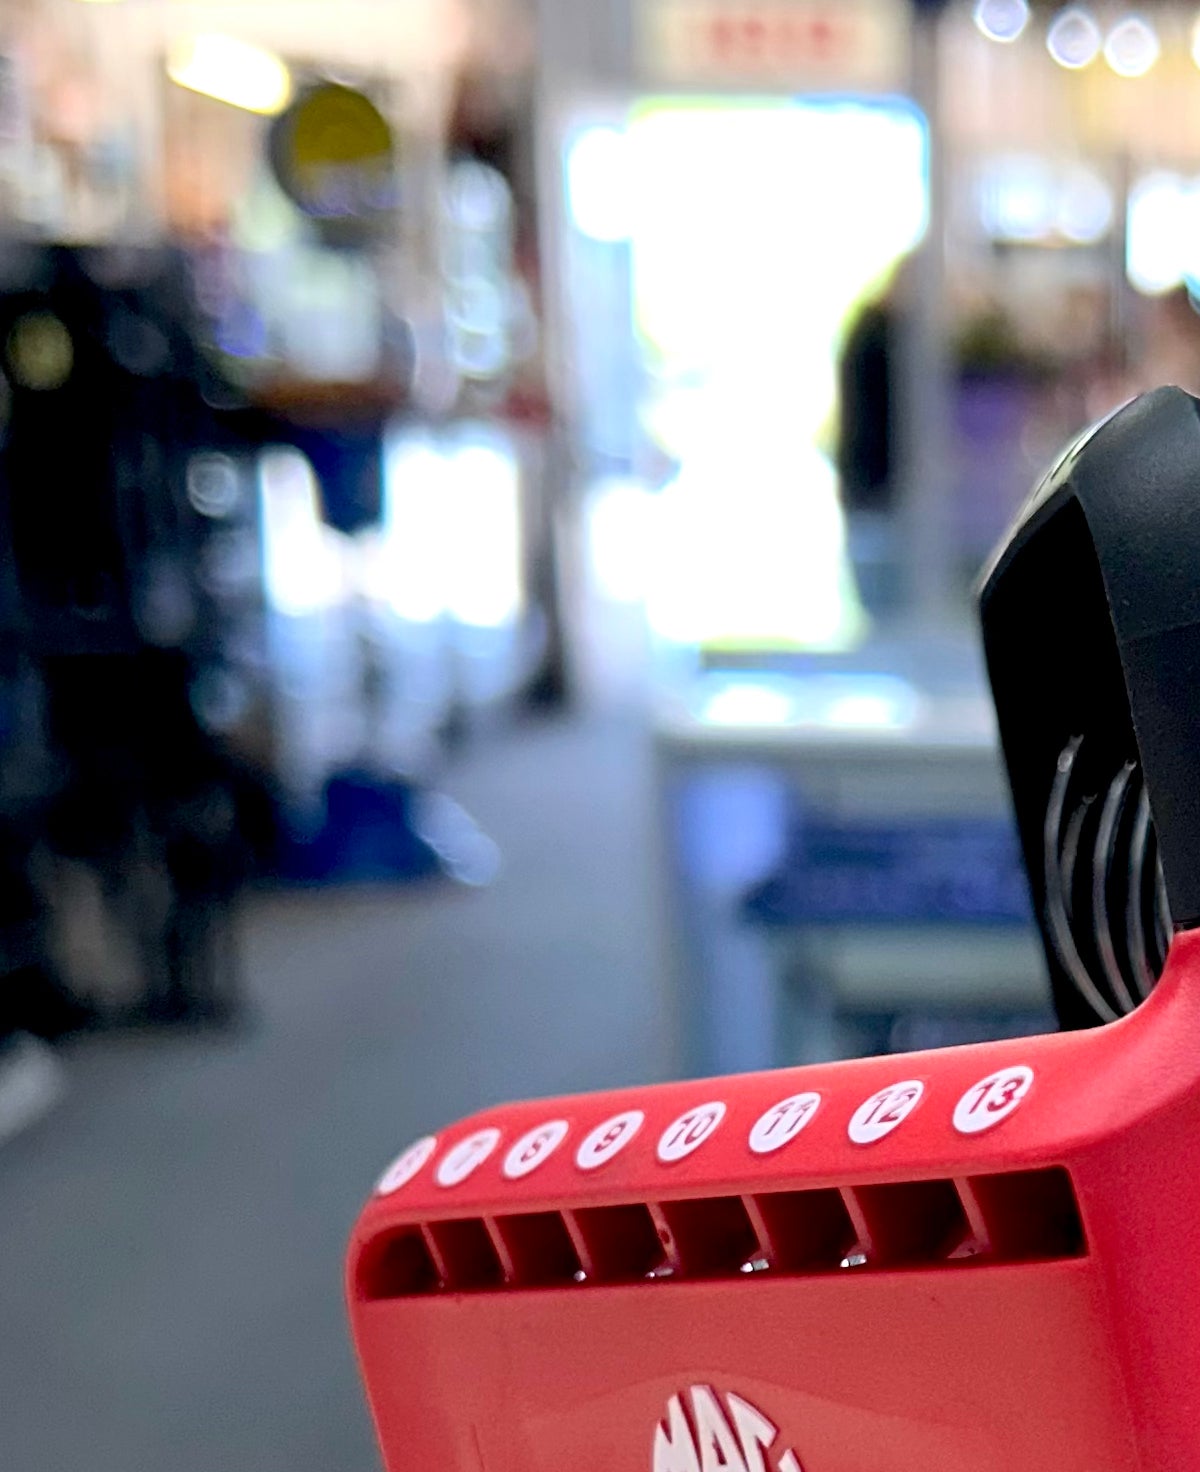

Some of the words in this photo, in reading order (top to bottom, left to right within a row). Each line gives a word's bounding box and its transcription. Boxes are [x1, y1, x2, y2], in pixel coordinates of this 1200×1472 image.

[593, 1120, 628, 1153] 9
[666, 1111, 719, 1148] 10
[763, 1098, 817, 1137] 11
[862, 1087, 919, 1126] 12
[968, 1074, 1026, 1115] 13
